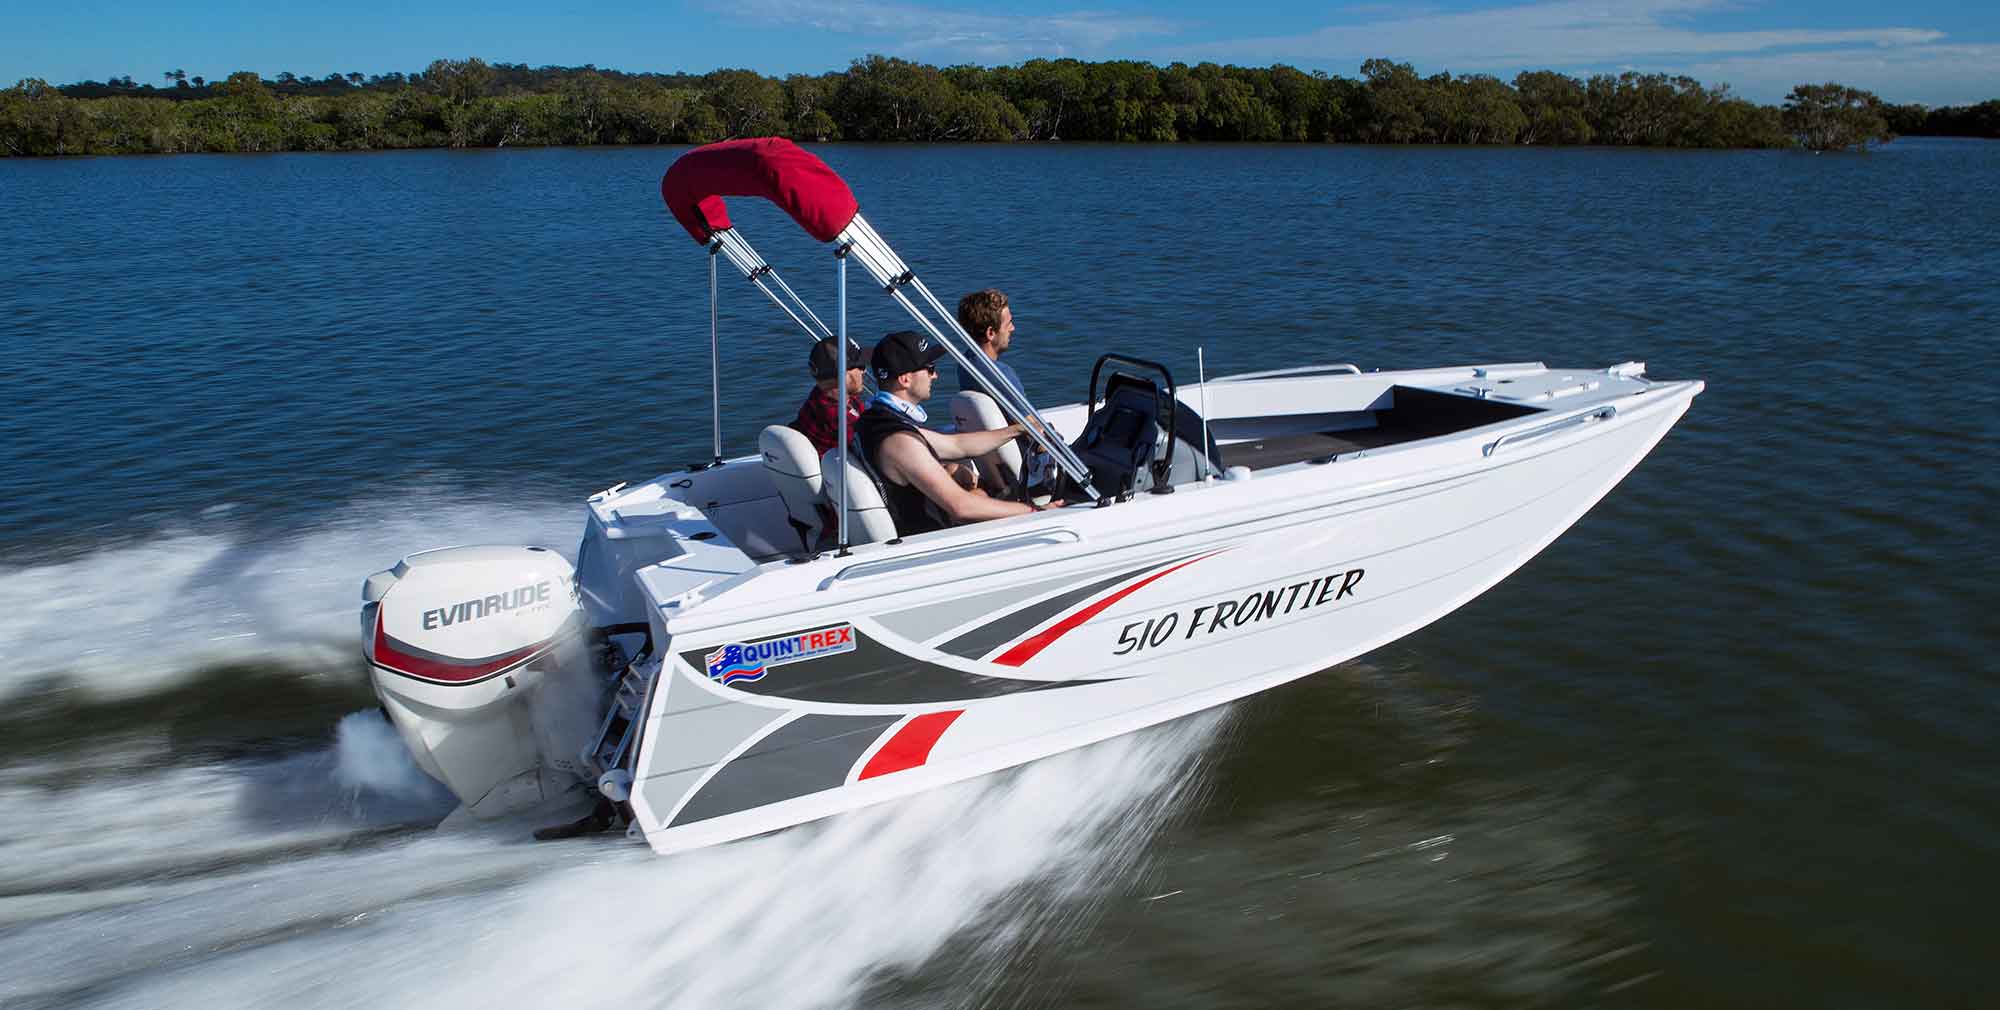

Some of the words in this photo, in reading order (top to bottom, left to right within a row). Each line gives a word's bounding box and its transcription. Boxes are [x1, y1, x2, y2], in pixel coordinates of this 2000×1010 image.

[422, 581, 552, 630] EVINRUDE
[1112, 612, 1179, 655] 510
[1185, 568, 1366, 640] FRONTIER
[743, 626, 852, 663] QUINTREX
